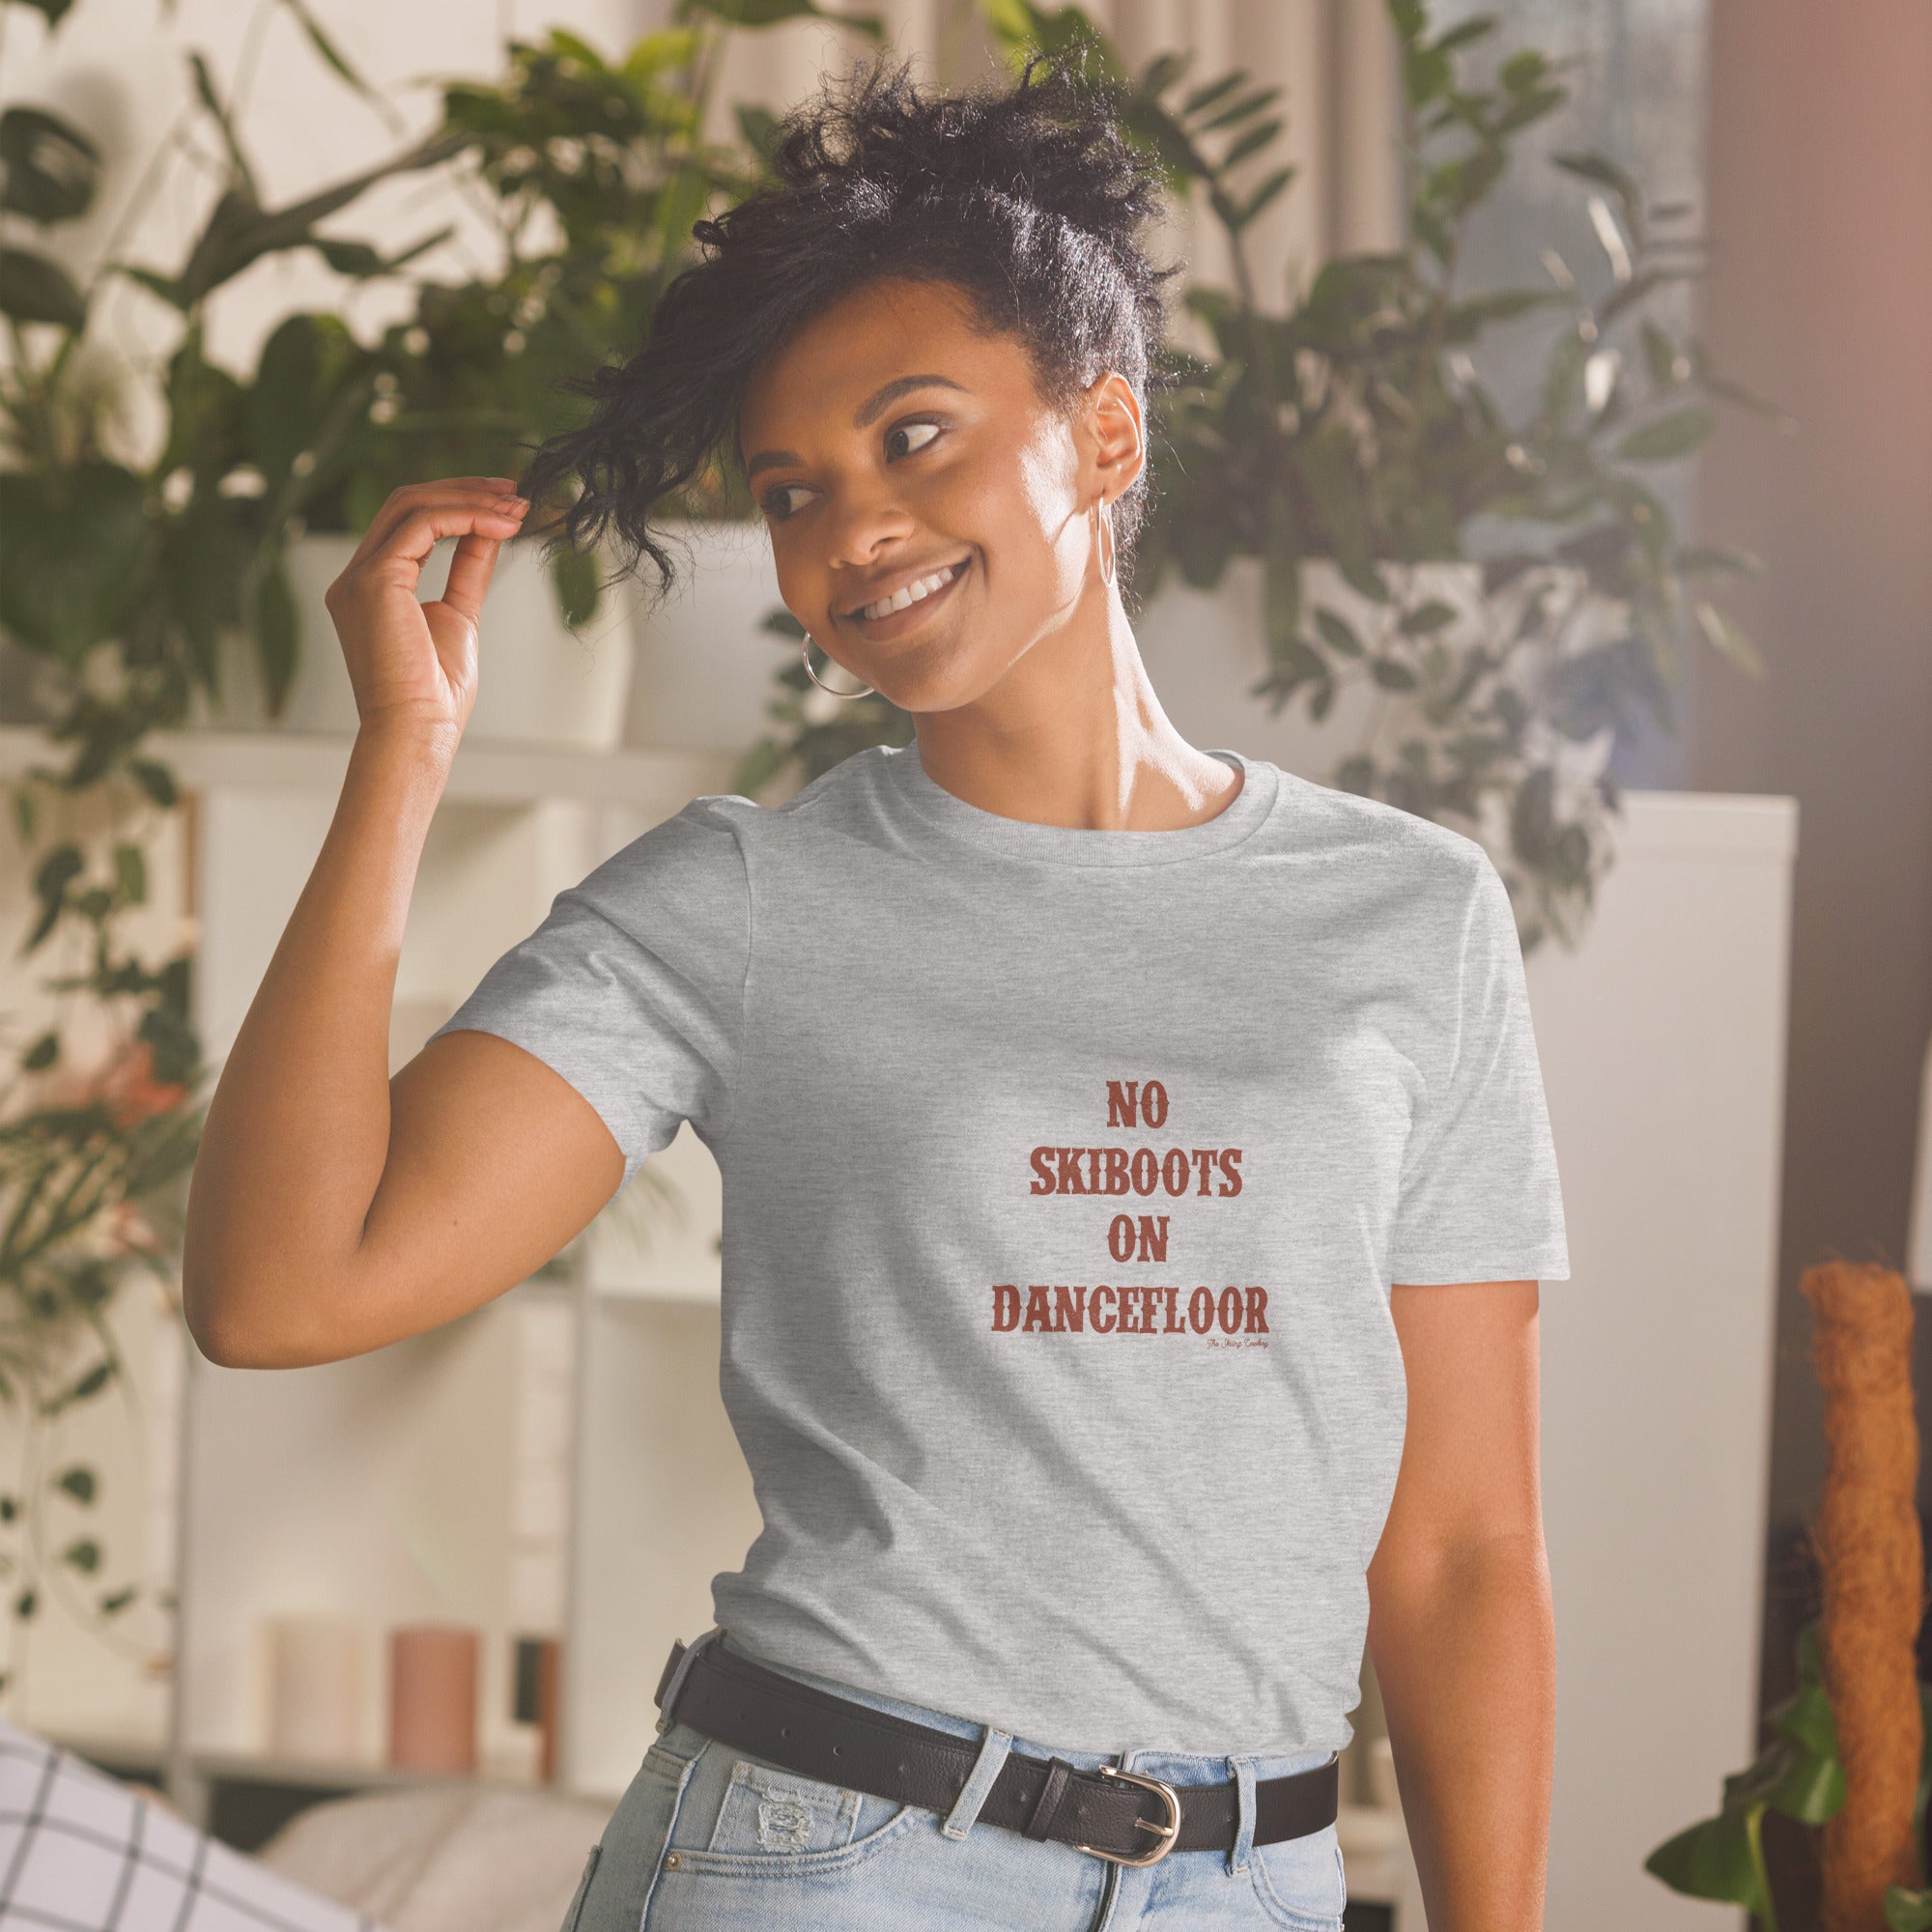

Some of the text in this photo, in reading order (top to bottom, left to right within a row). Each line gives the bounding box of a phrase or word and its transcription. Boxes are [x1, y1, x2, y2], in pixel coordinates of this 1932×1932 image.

[1106, 1080, 1170, 1128] NO
[1030, 1146, 1243, 1198] SKIBOOTS
[1107, 1214, 1170, 1263] ON
[991, 1285, 1269, 1335] DANCEFLOOR
